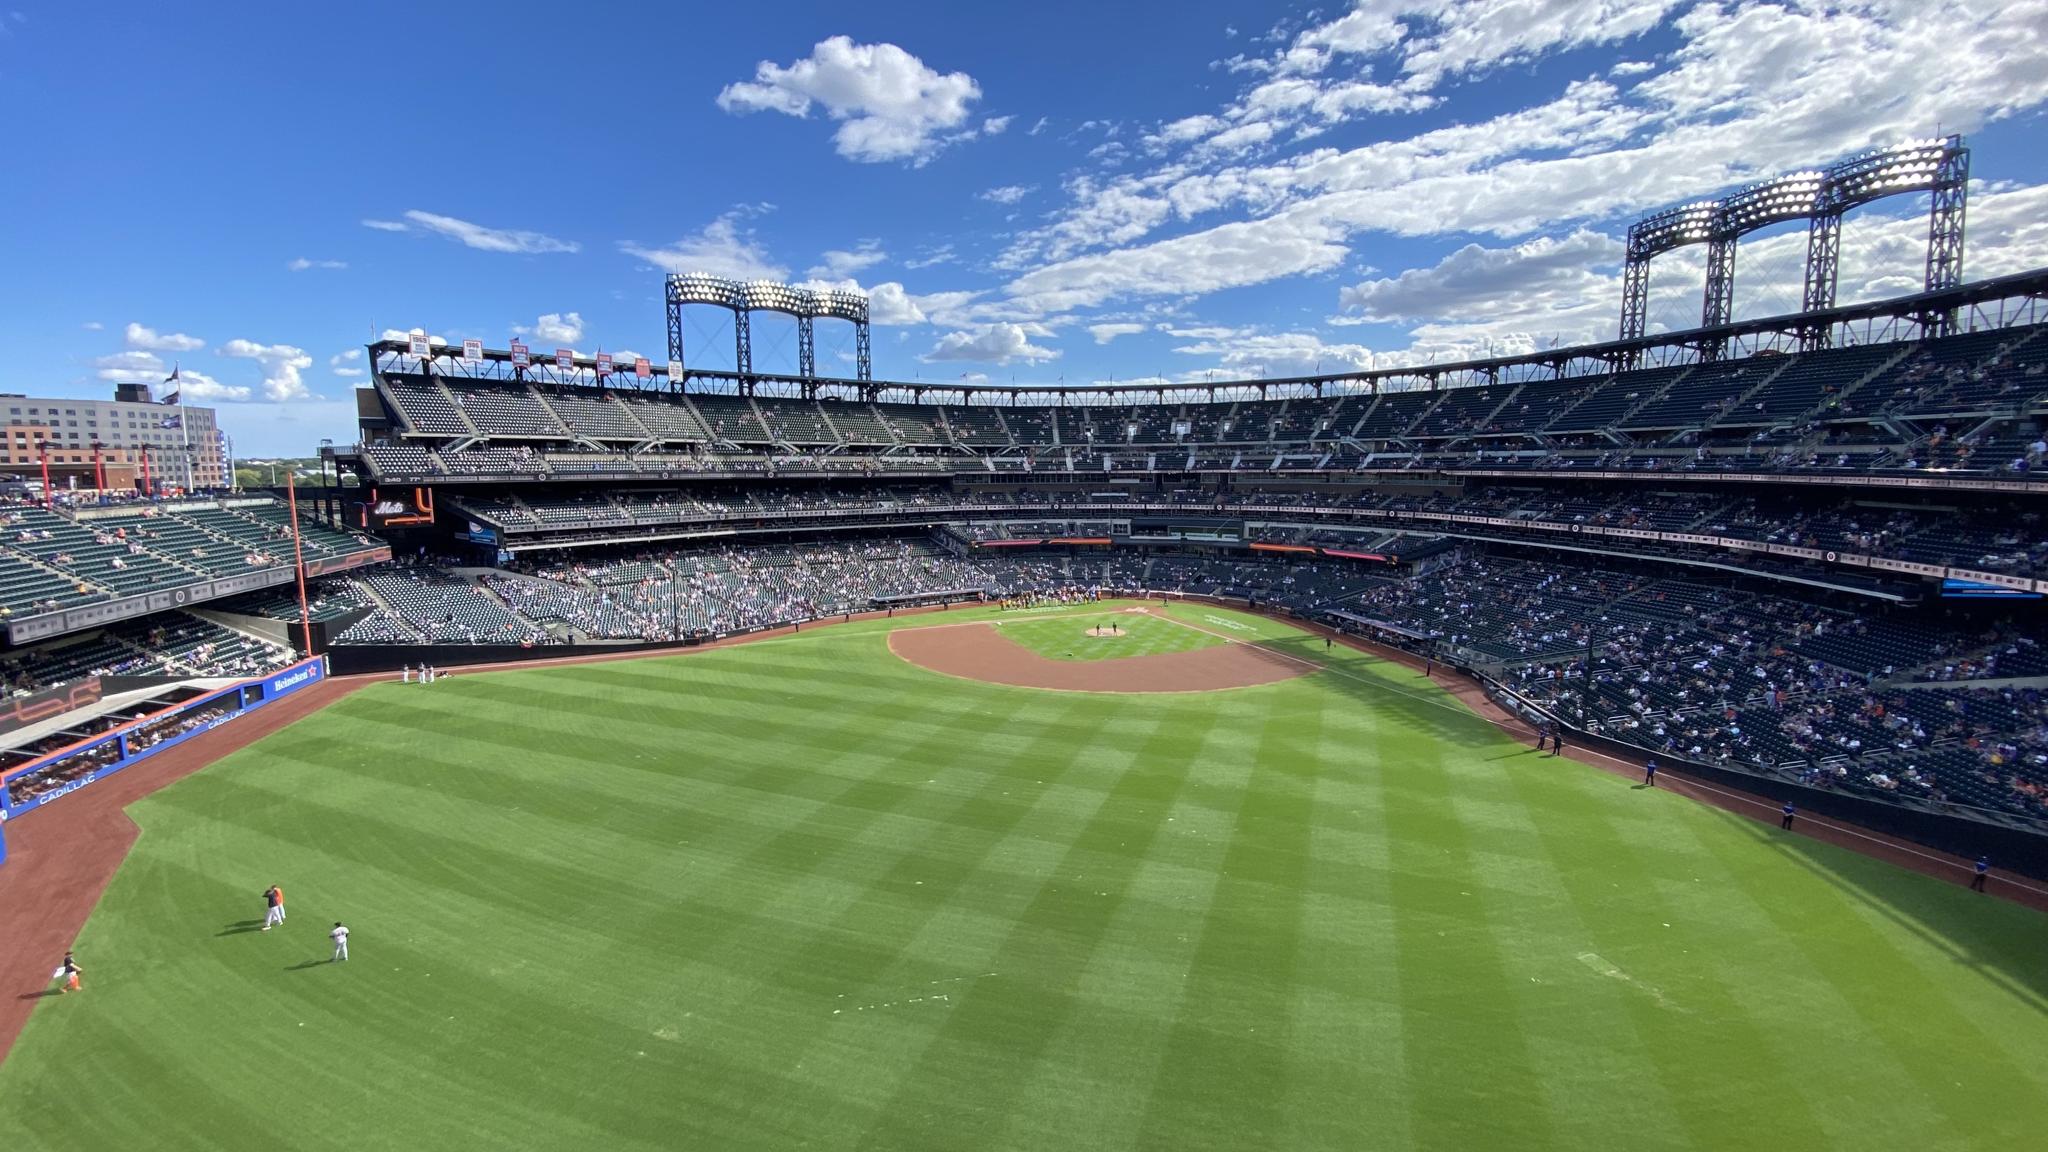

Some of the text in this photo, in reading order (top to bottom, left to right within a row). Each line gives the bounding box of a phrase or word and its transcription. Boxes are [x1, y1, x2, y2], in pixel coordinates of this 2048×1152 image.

[375, 501, 403, 514] Mets
[274, 670, 308, 692] Heineken
[208, 708, 246, 730] CADILLAC
[40, 775, 96, 805] CADILLAC
[0, 809, 8, 820] 0
